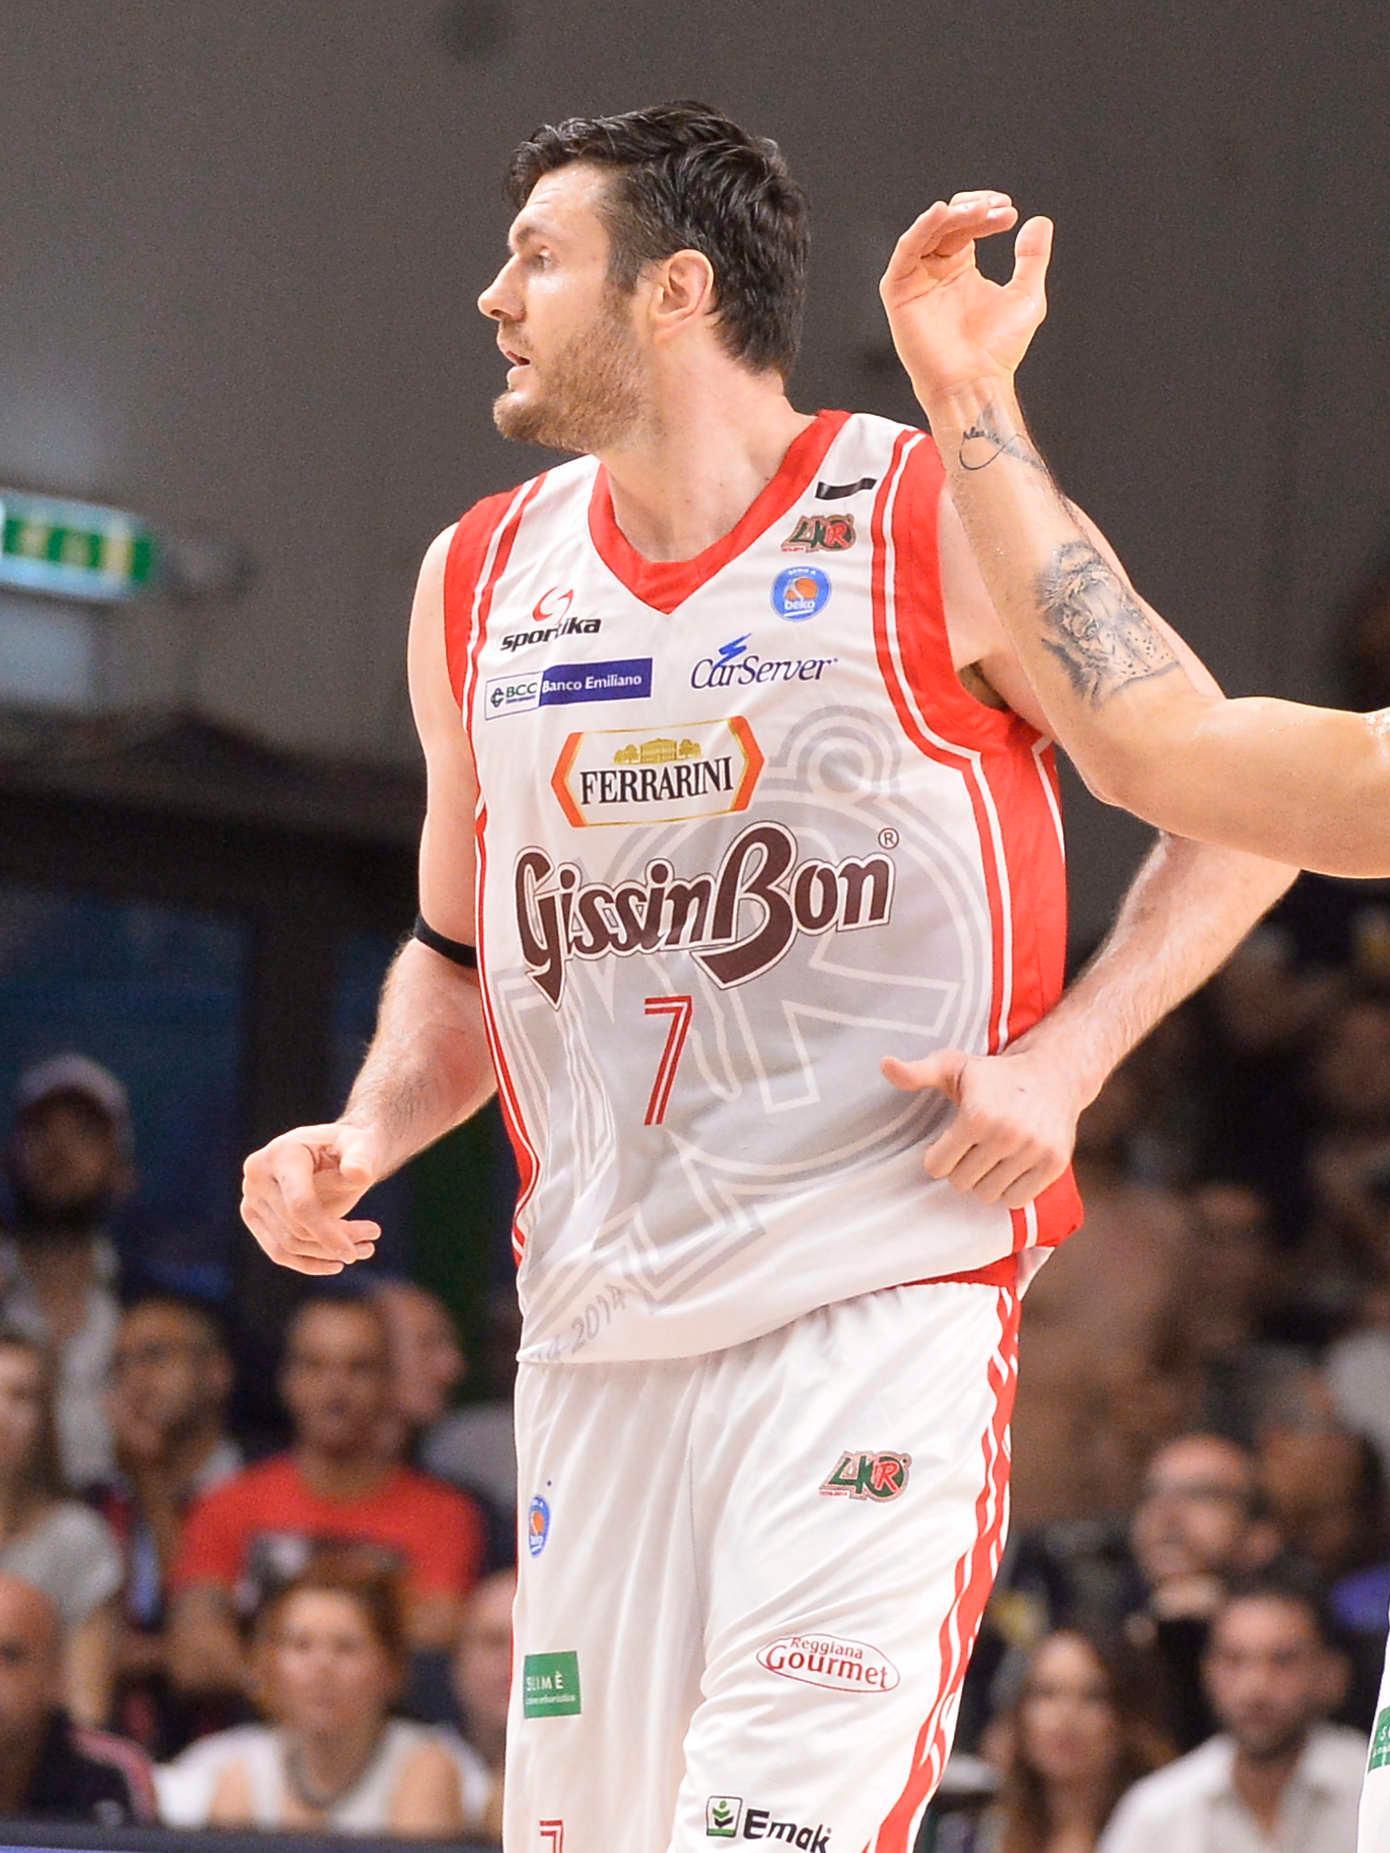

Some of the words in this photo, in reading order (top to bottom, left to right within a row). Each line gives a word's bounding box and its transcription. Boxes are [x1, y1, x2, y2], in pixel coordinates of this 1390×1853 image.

[506, 682, 538, 698] BCC
[541, 679, 582, 694] Banco
[585, 673, 642, 689] Emiliano
[691, 654, 832, 689] CarServer
[580, 755, 734, 806] FERRARINI
[644, 995, 693, 1126] 7
[766, 1645, 888, 1689] Gourmet
[790, 1636, 864, 1660] Reggiana
[743, 1808, 831, 1853] Emak
